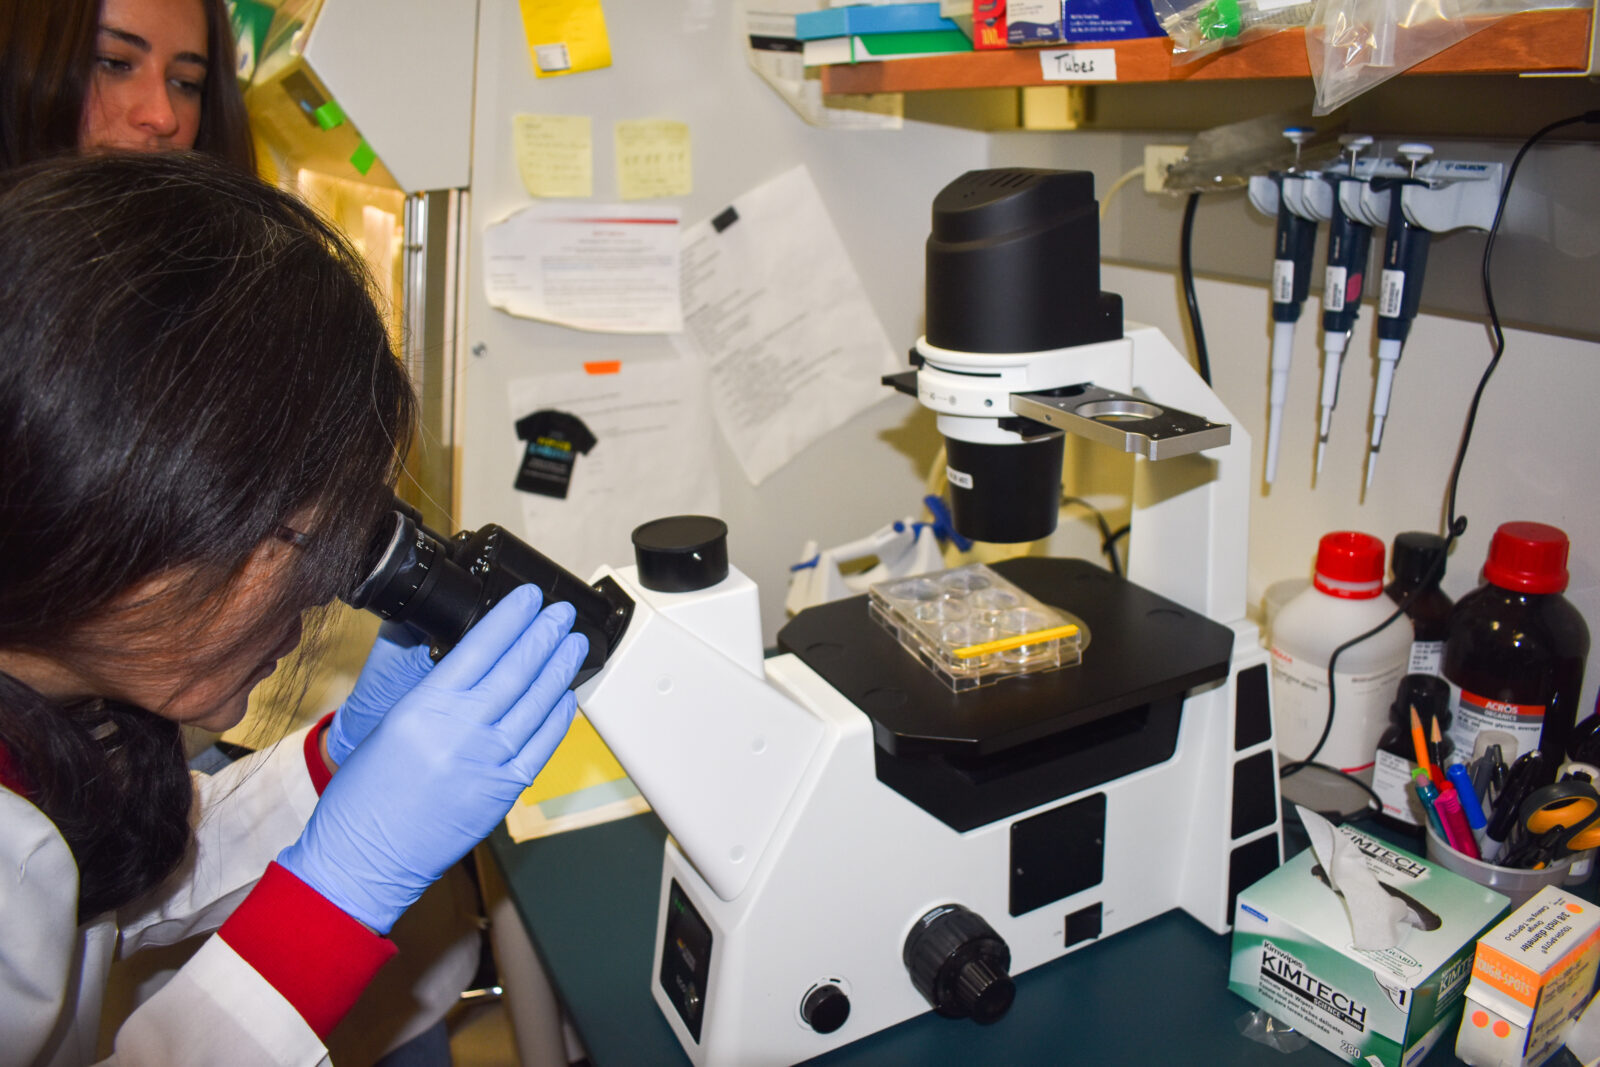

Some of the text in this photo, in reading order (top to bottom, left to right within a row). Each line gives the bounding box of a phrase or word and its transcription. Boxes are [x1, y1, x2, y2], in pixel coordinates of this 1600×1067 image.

[1054, 53, 1094, 73] Tubes
[1483, 710, 1518, 721] ORGANICS
[1485, 701, 1518, 713] ACROS
[1520, 912, 1571, 953] 3/8 inch diameter
[1264, 940, 1303, 969] Kimwipes
[1262, 951, 1367, 1023] KIMTECH
[1475, 957, 1531, 996] TOUGH-SPOTS
[1282, 986, 1294, 998] Task
[1295, 994, 1314, 1010] Wipers
[1399, 989, 1406, 1005] 1
[1340, 1040, 1361, 1059] 280
